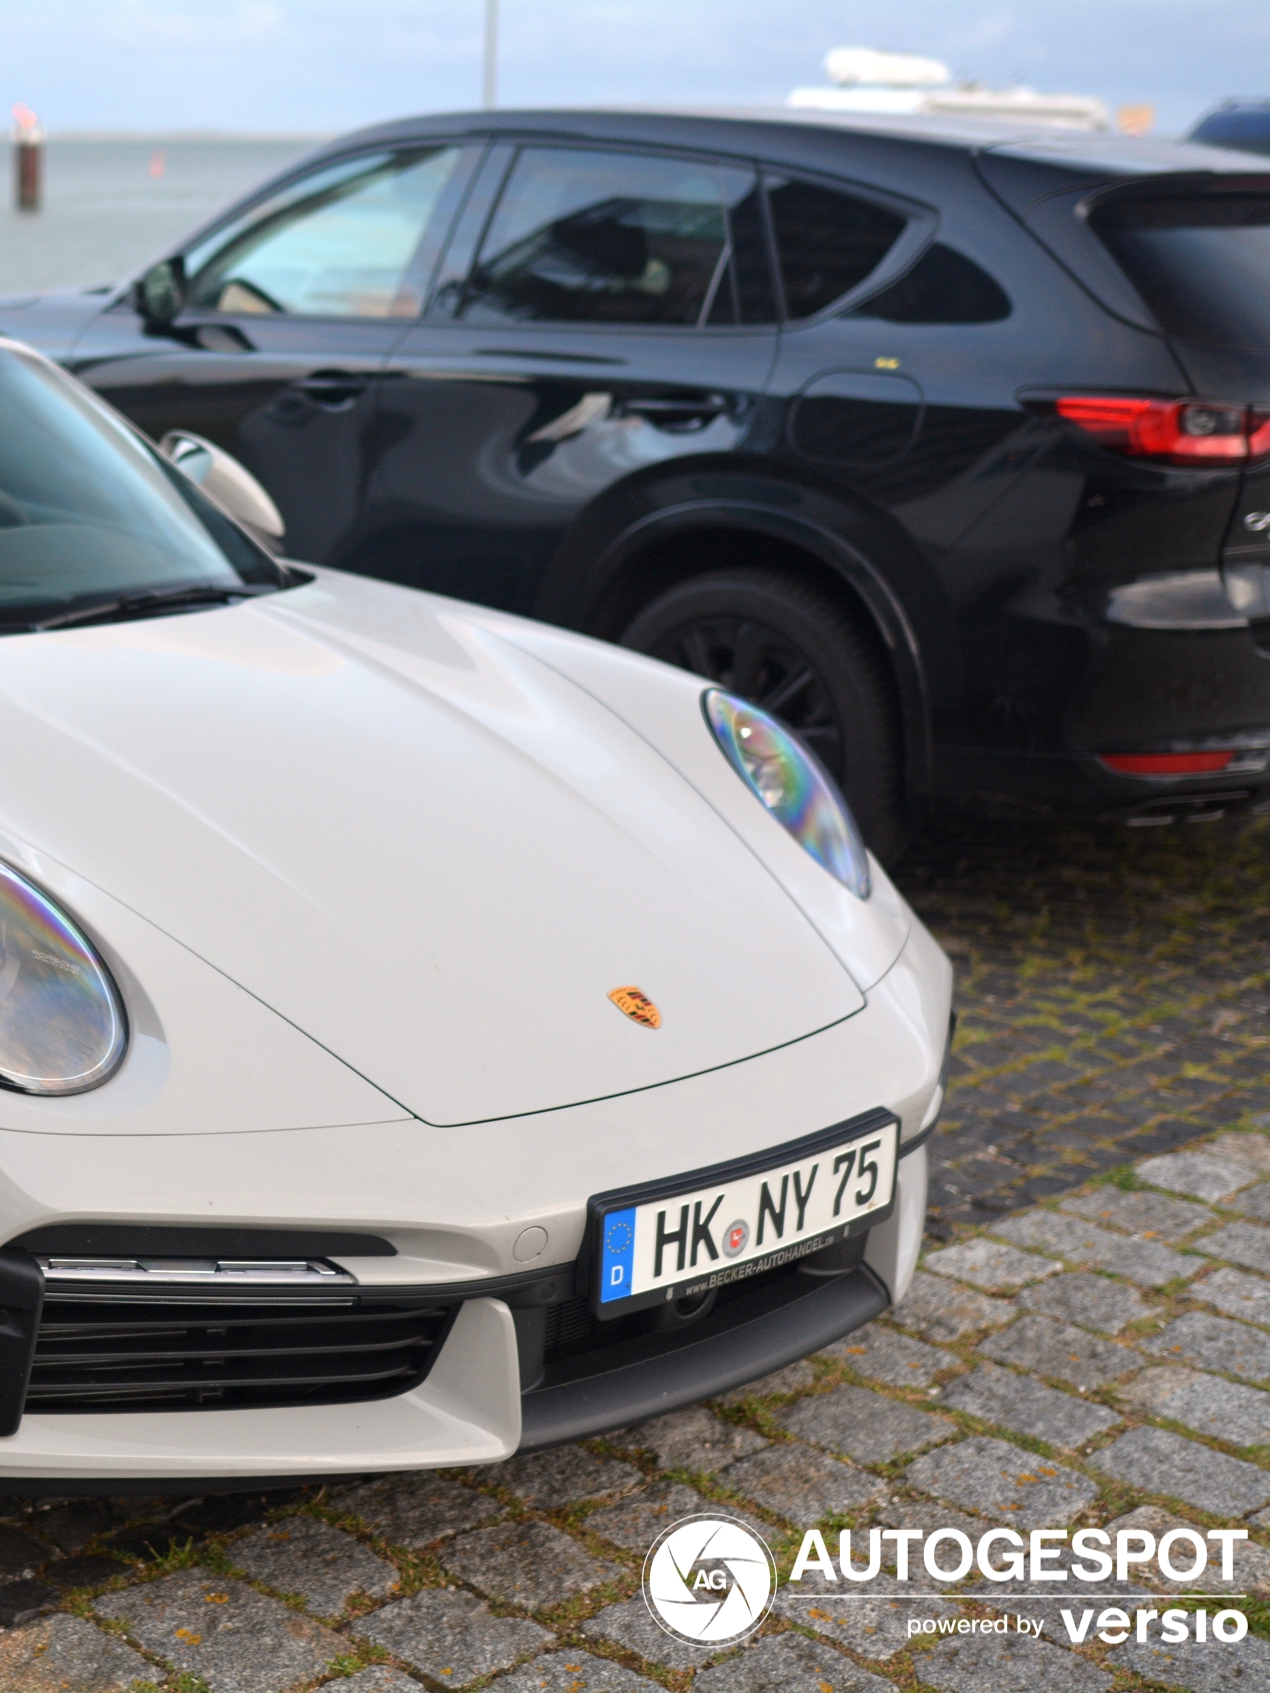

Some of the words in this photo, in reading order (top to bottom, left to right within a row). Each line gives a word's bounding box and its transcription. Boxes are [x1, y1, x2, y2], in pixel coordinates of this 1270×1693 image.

[653, 1193, 725, 1278] HK
[755, 1163, 819, 1246] NY
[832, 1137, 882, 1218] 75
[610, 1264, 624, 1286] D
[685, 1235, 834, 1295] www.BECKER-AUTOHANDEL.de
